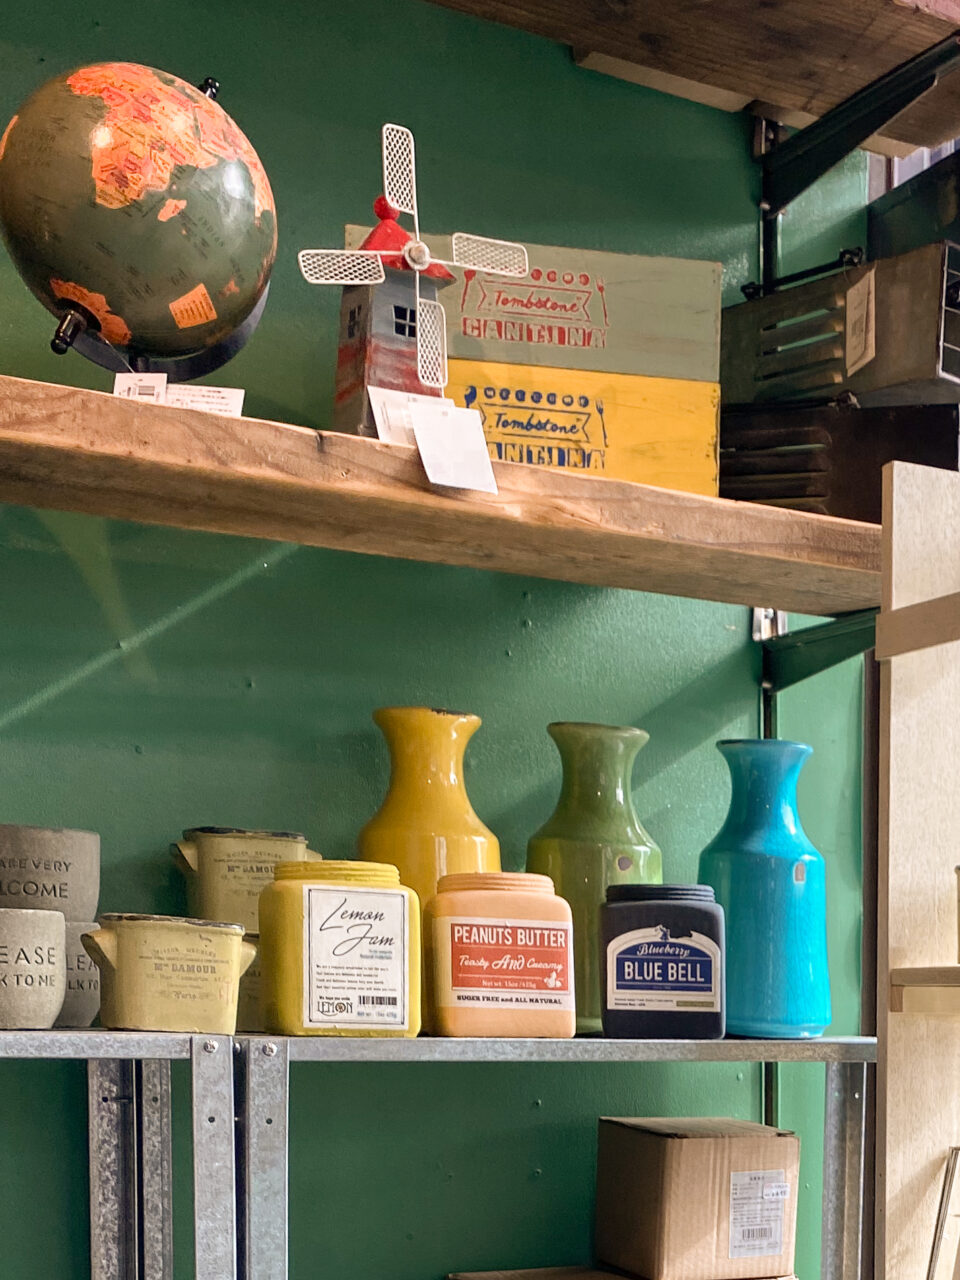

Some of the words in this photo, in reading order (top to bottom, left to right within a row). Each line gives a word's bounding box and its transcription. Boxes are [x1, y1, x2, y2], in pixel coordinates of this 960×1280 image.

[496, 290, 580, 313] Tombstone
[462, 317, 606, 348] CANTINA
[496, 412, 580, 434] Tombstone
[486, 442, 606, 469] ANTINA
[31, 861, 72, 872] VERY
[319, 897, 385, 931] Lemon
[332, 923, 395, 956] Jam
[454, 925, 513, 945] PEANUTS
[517, 929, 566, 948] BUTTER
[637, 943, 691, 958] Blueberry
[171, 963, 217, 974] DAMOUR
[491, 954, 526, 971] And
[624, 961, 663, 981] BLUE
[667, 962, 705, 982] BELL
[13, 974, 34, 987] TO
[39, 975, 56, 987] ME
[317, 1001, 353, 1016] LEMON
[482, 995, 500, 1003] FREE
